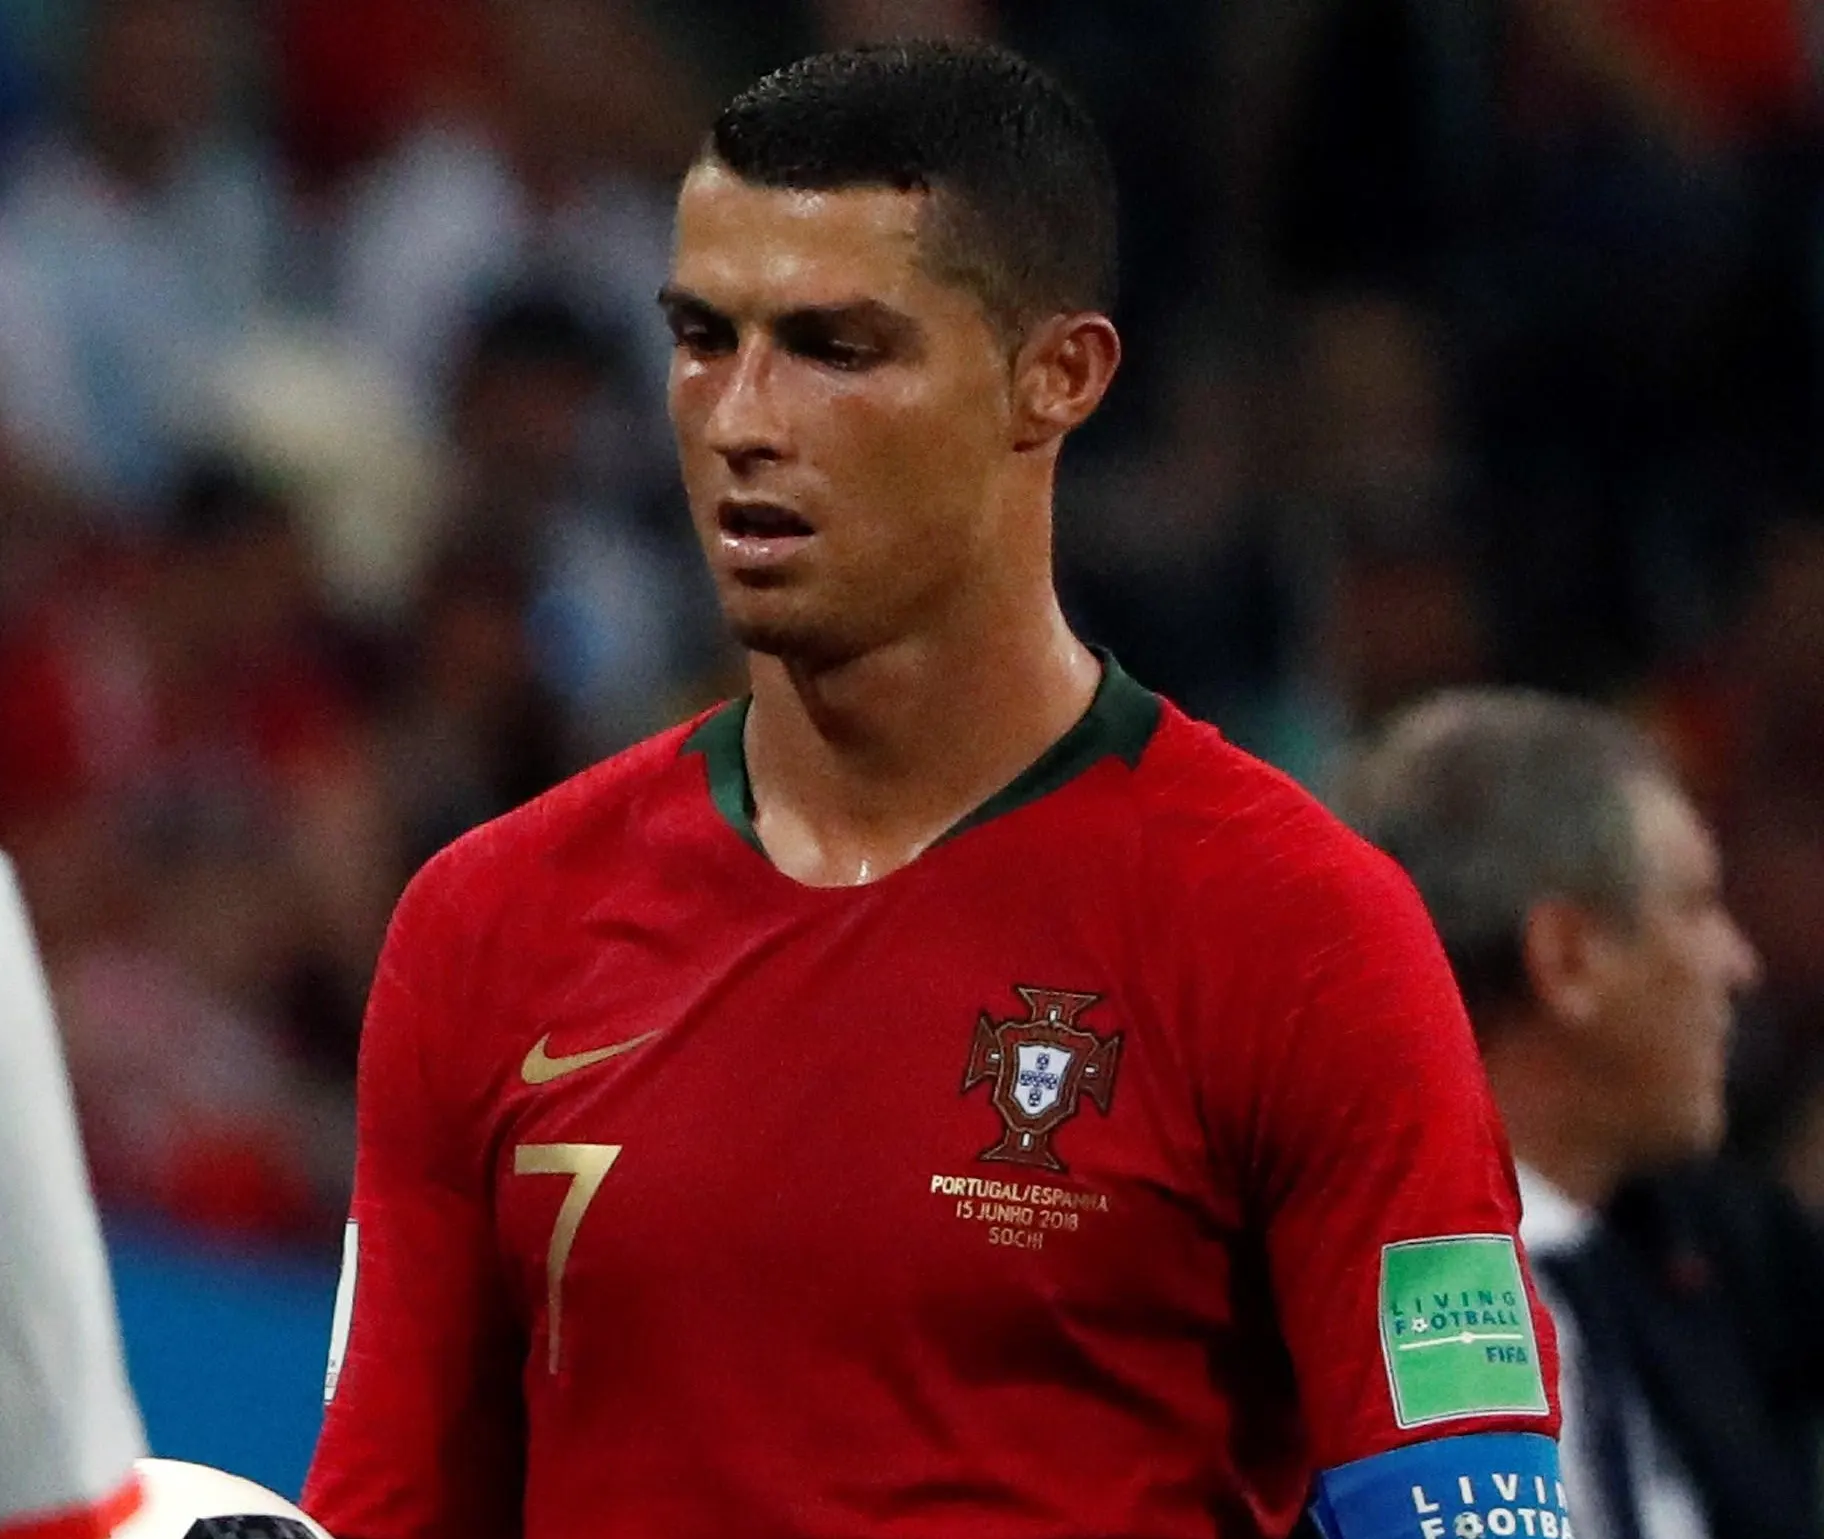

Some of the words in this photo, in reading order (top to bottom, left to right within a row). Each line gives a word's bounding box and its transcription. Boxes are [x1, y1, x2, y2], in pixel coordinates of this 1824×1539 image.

[956, 1201, 973, 1219] 15
[977, 1203, 1034, 1224] JUNHO
[1039, 1211, 1079, 1231] 2018
[988, 1226, 1043, 1249] SOCHI
[514, 1142, 624, 1375] 7
[1391, 1290, 1516, 1316] LIVING
[1486, 1346, 1528, 1364] FIFA
